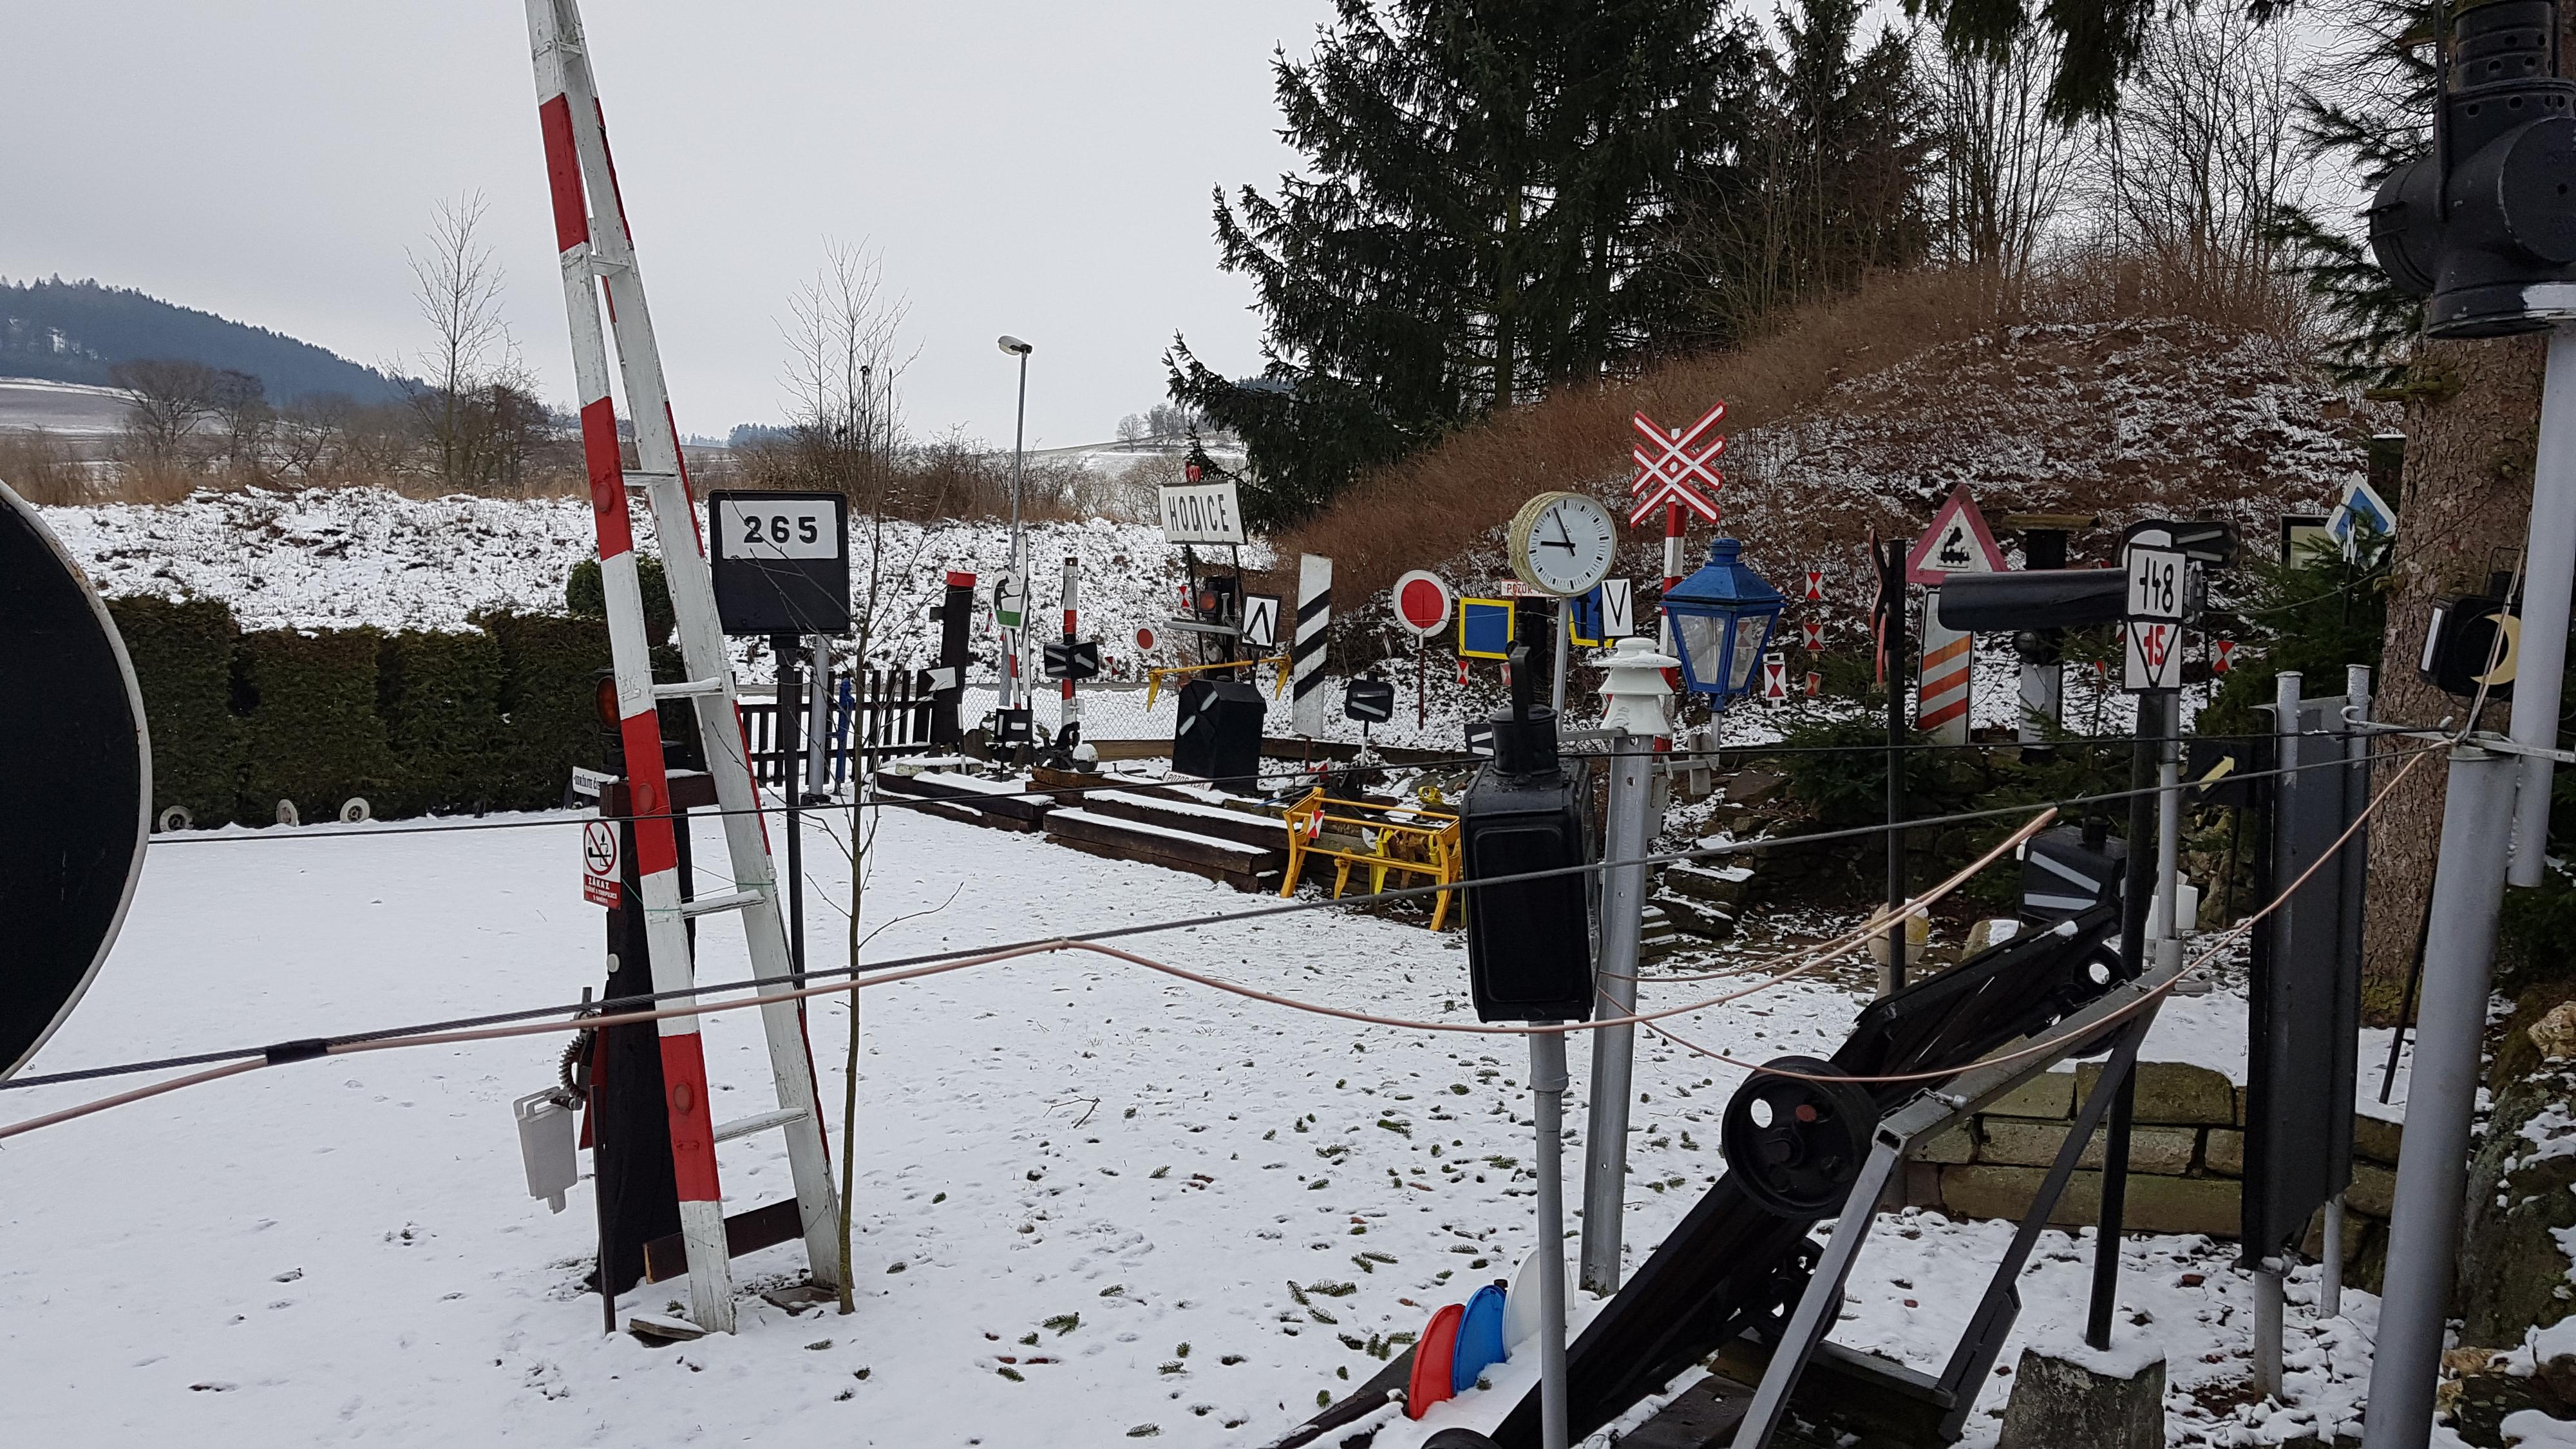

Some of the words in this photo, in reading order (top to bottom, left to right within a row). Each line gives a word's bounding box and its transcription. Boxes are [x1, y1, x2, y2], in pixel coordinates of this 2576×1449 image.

[743, 515, 818, 544] 265
[1168, 493, 1229, 531] HODICE
[2139, 556, 2174, 613] 148
[2143, 625, 2166, 667] 15
[588, 876, 610, 890] ZÁKAZ
